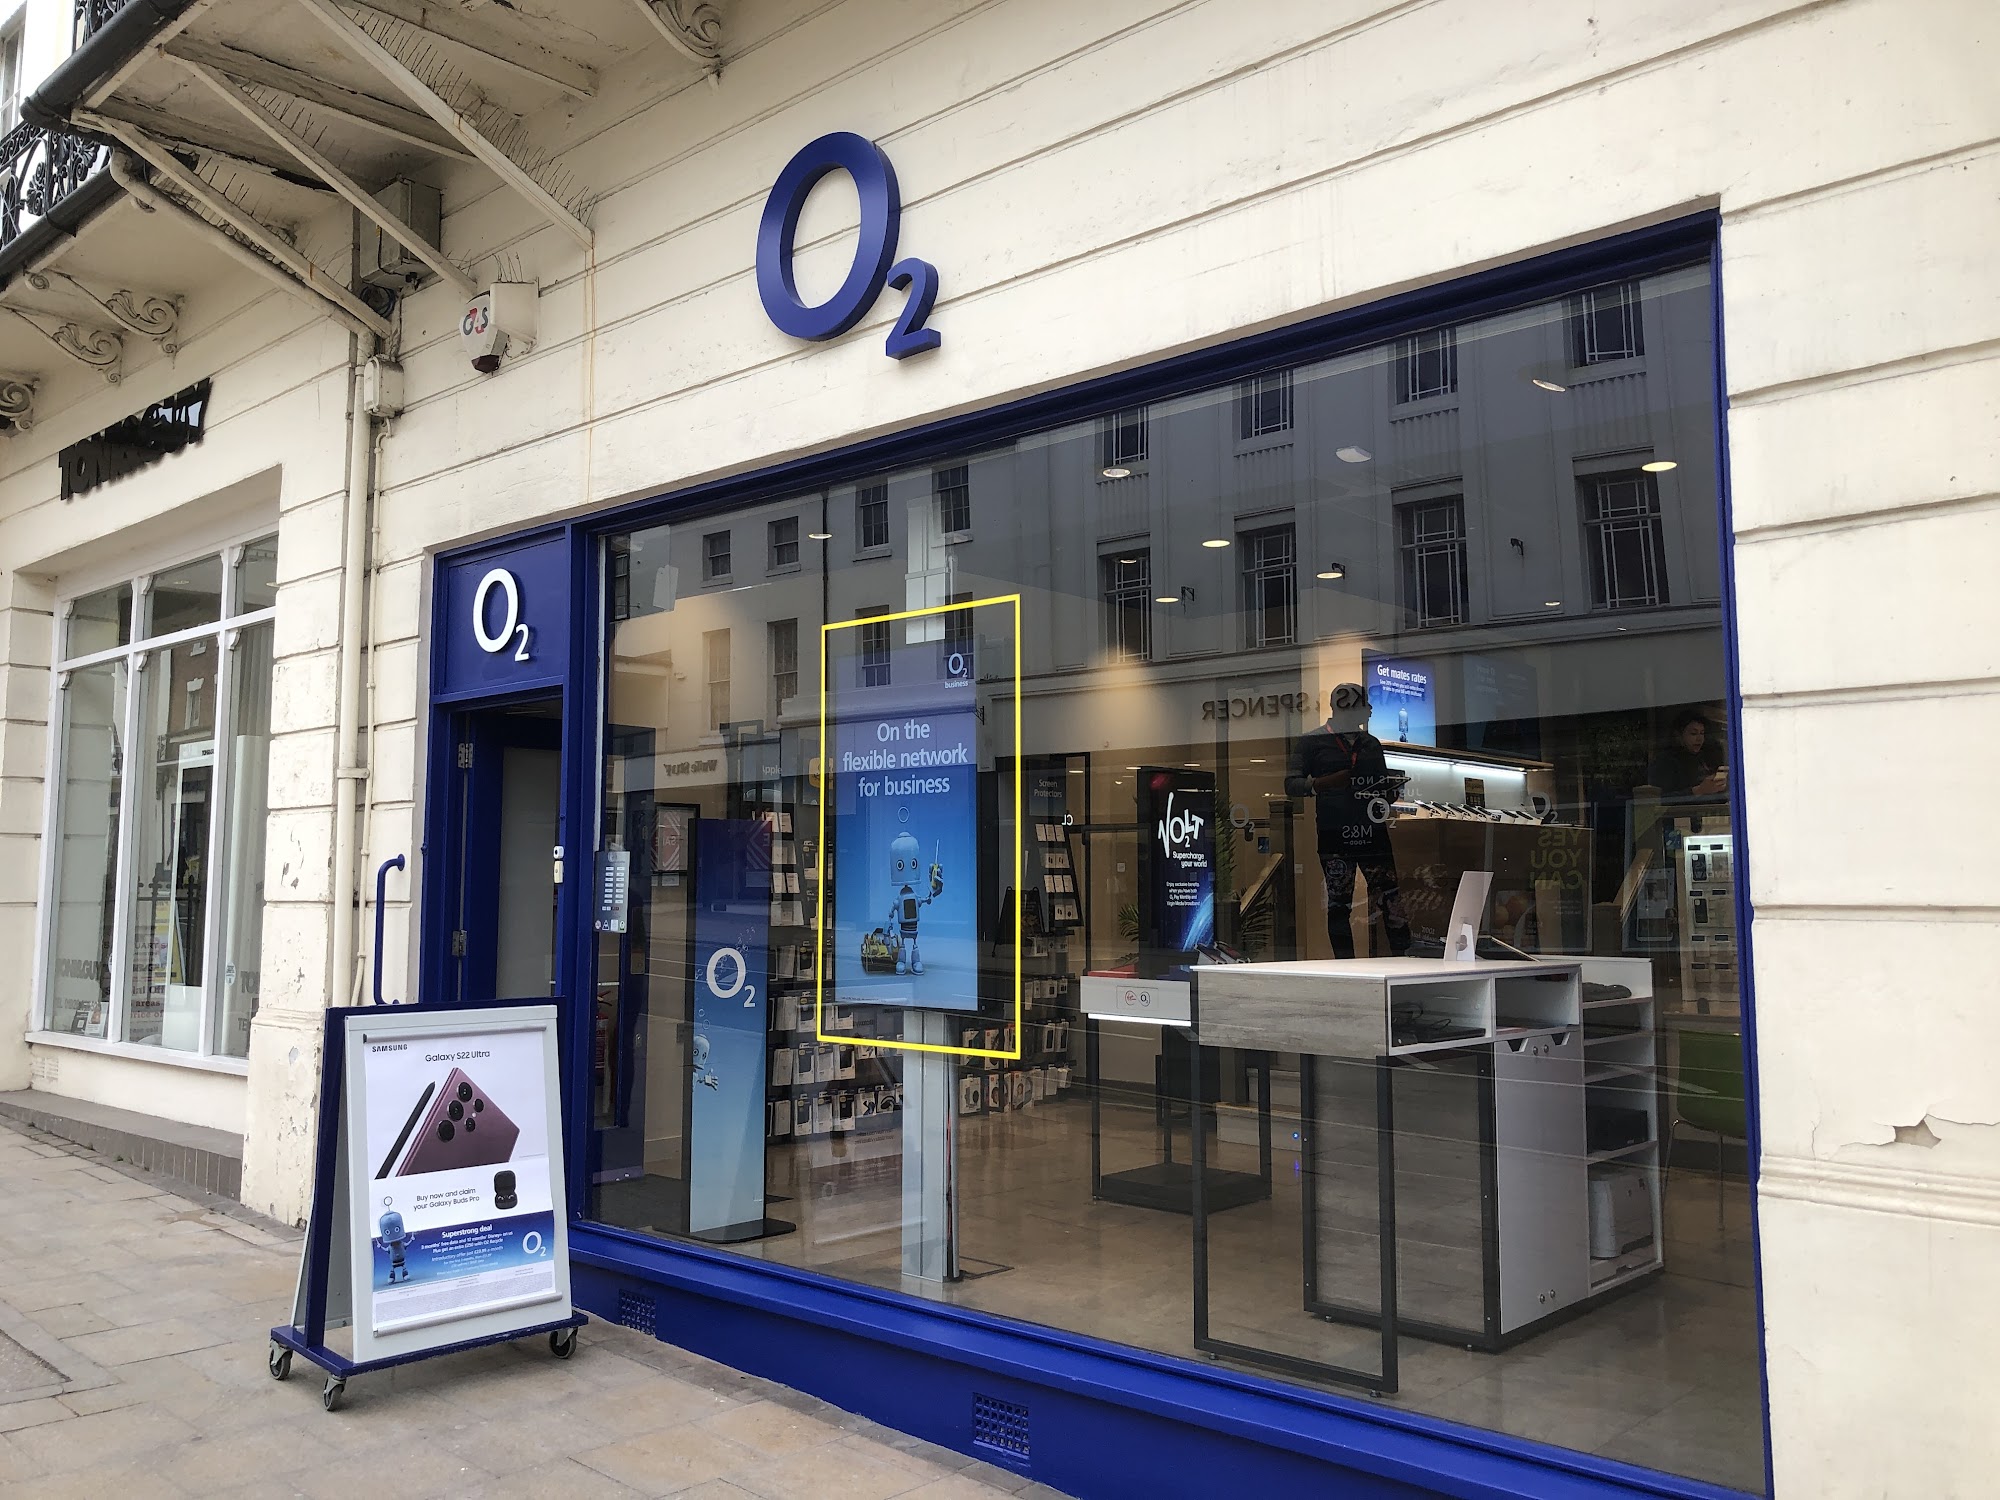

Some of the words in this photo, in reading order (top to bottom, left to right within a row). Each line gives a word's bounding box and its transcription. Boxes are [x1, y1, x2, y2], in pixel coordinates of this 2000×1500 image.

[1377, 664, 1390, 677] Get
[1391, 669, 1410, 681] mates
[1411, 673, 1427, 684] rates
[944, 680, 969, 689] business
[877, 722, 900, 742] On
[904, 719, 930, 740] the
[843, 749, 896, 771] flexible
[901, 743, 968, 767] network
[858, 776, 880, 797] for
[884, 774, 950, 796] business
[1038, 779, 1058, 788] Screen
[1033, 788, 1062, 798] Protectors
[1172, 851, 1205, 861] Supercharge
[1180, 860, 1194, 869] your
[1194, 860, 1207, 868] world
[372, 1044, 408, 1053] SAMSUNG
[425, 1052, 455, 1063] Galaxy
[456, 1051, 470, 1060] S22
[471, 1050, 490, 1058] Ultra
[416, 1194, 428, 1202] Buy
[445, 1190, 458, 1198] and
[459, 1188, 476, 1196] claim
[413, 1203, 428, 1211] your
[429, 1200, 452, 1209] Galaxy
[453, 1197, 469, 1205] Buds
[442, 1228, 479, 1239] Superstrong
[480, 1224, 493, 1232] deal
